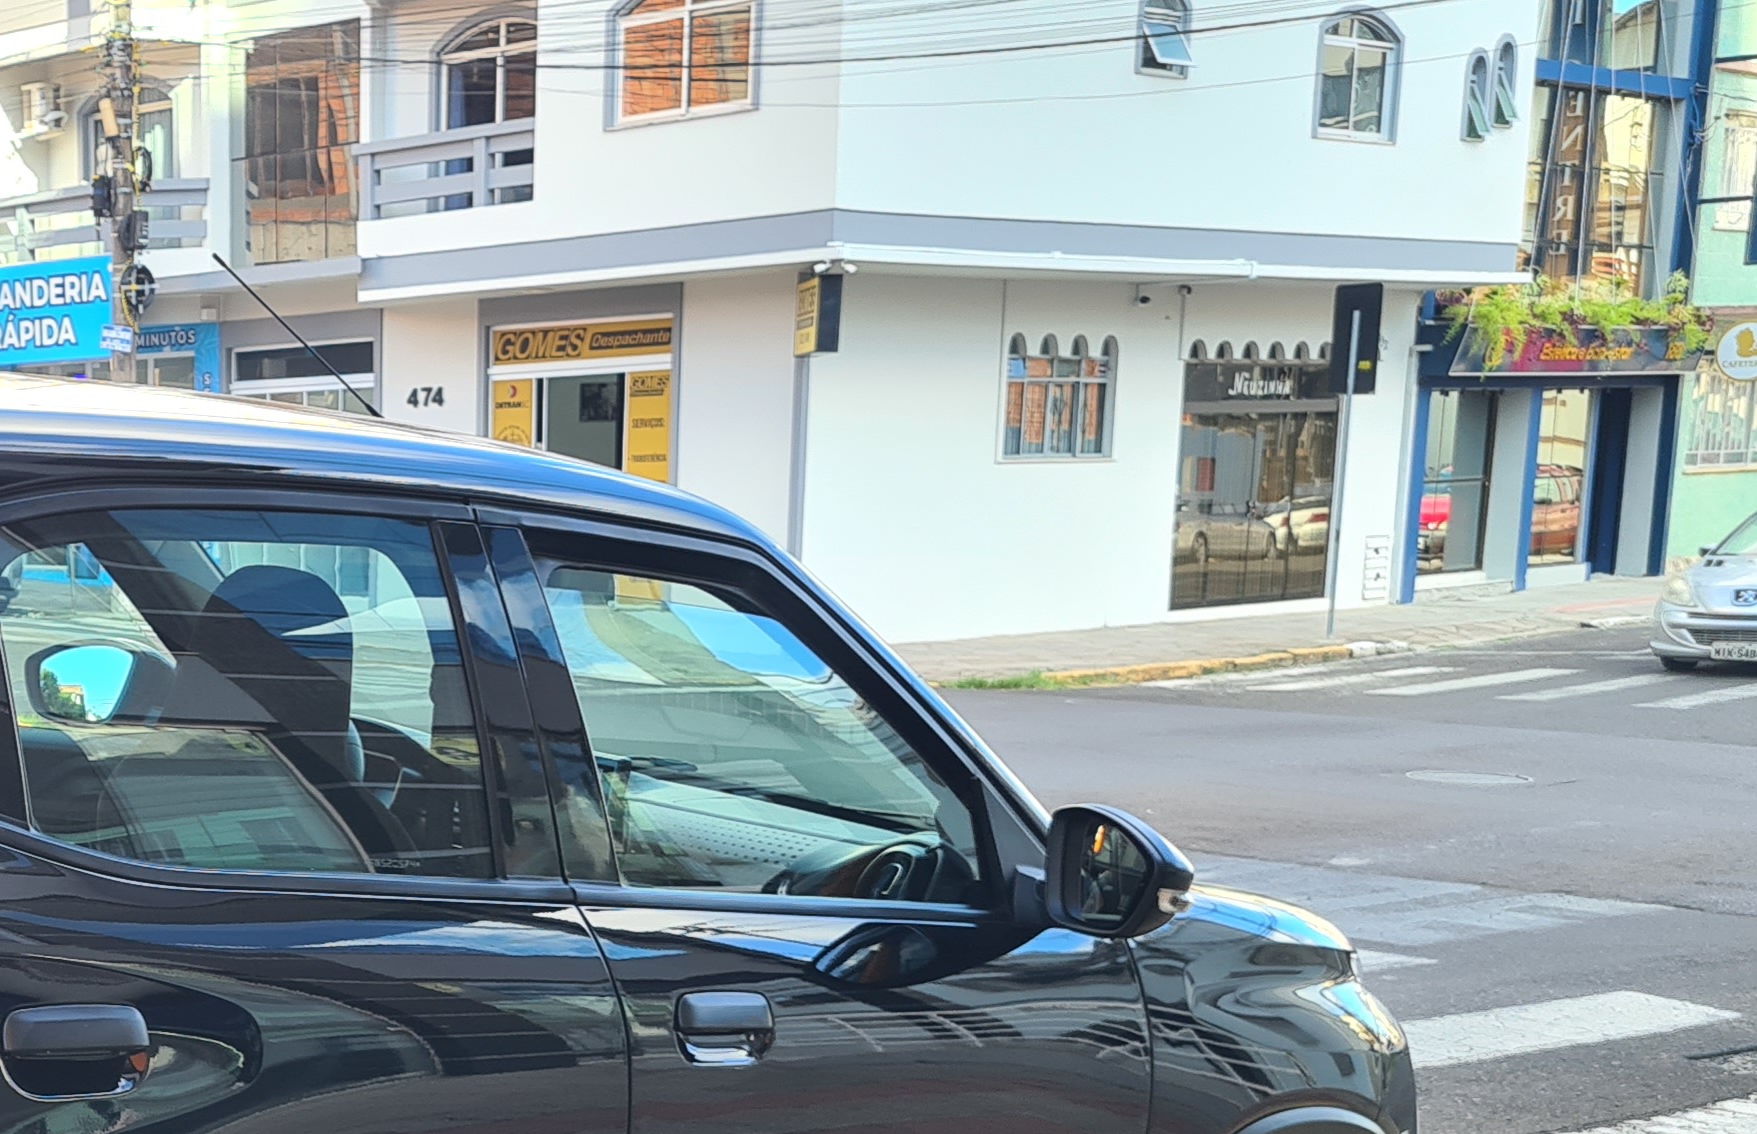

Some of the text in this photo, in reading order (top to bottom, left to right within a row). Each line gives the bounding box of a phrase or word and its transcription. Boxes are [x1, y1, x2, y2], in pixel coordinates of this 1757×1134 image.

[496, 328, 587, 361] GOMES
[591, 329, 671, 348] Despachante
[406, 387, 445, 407] 474
